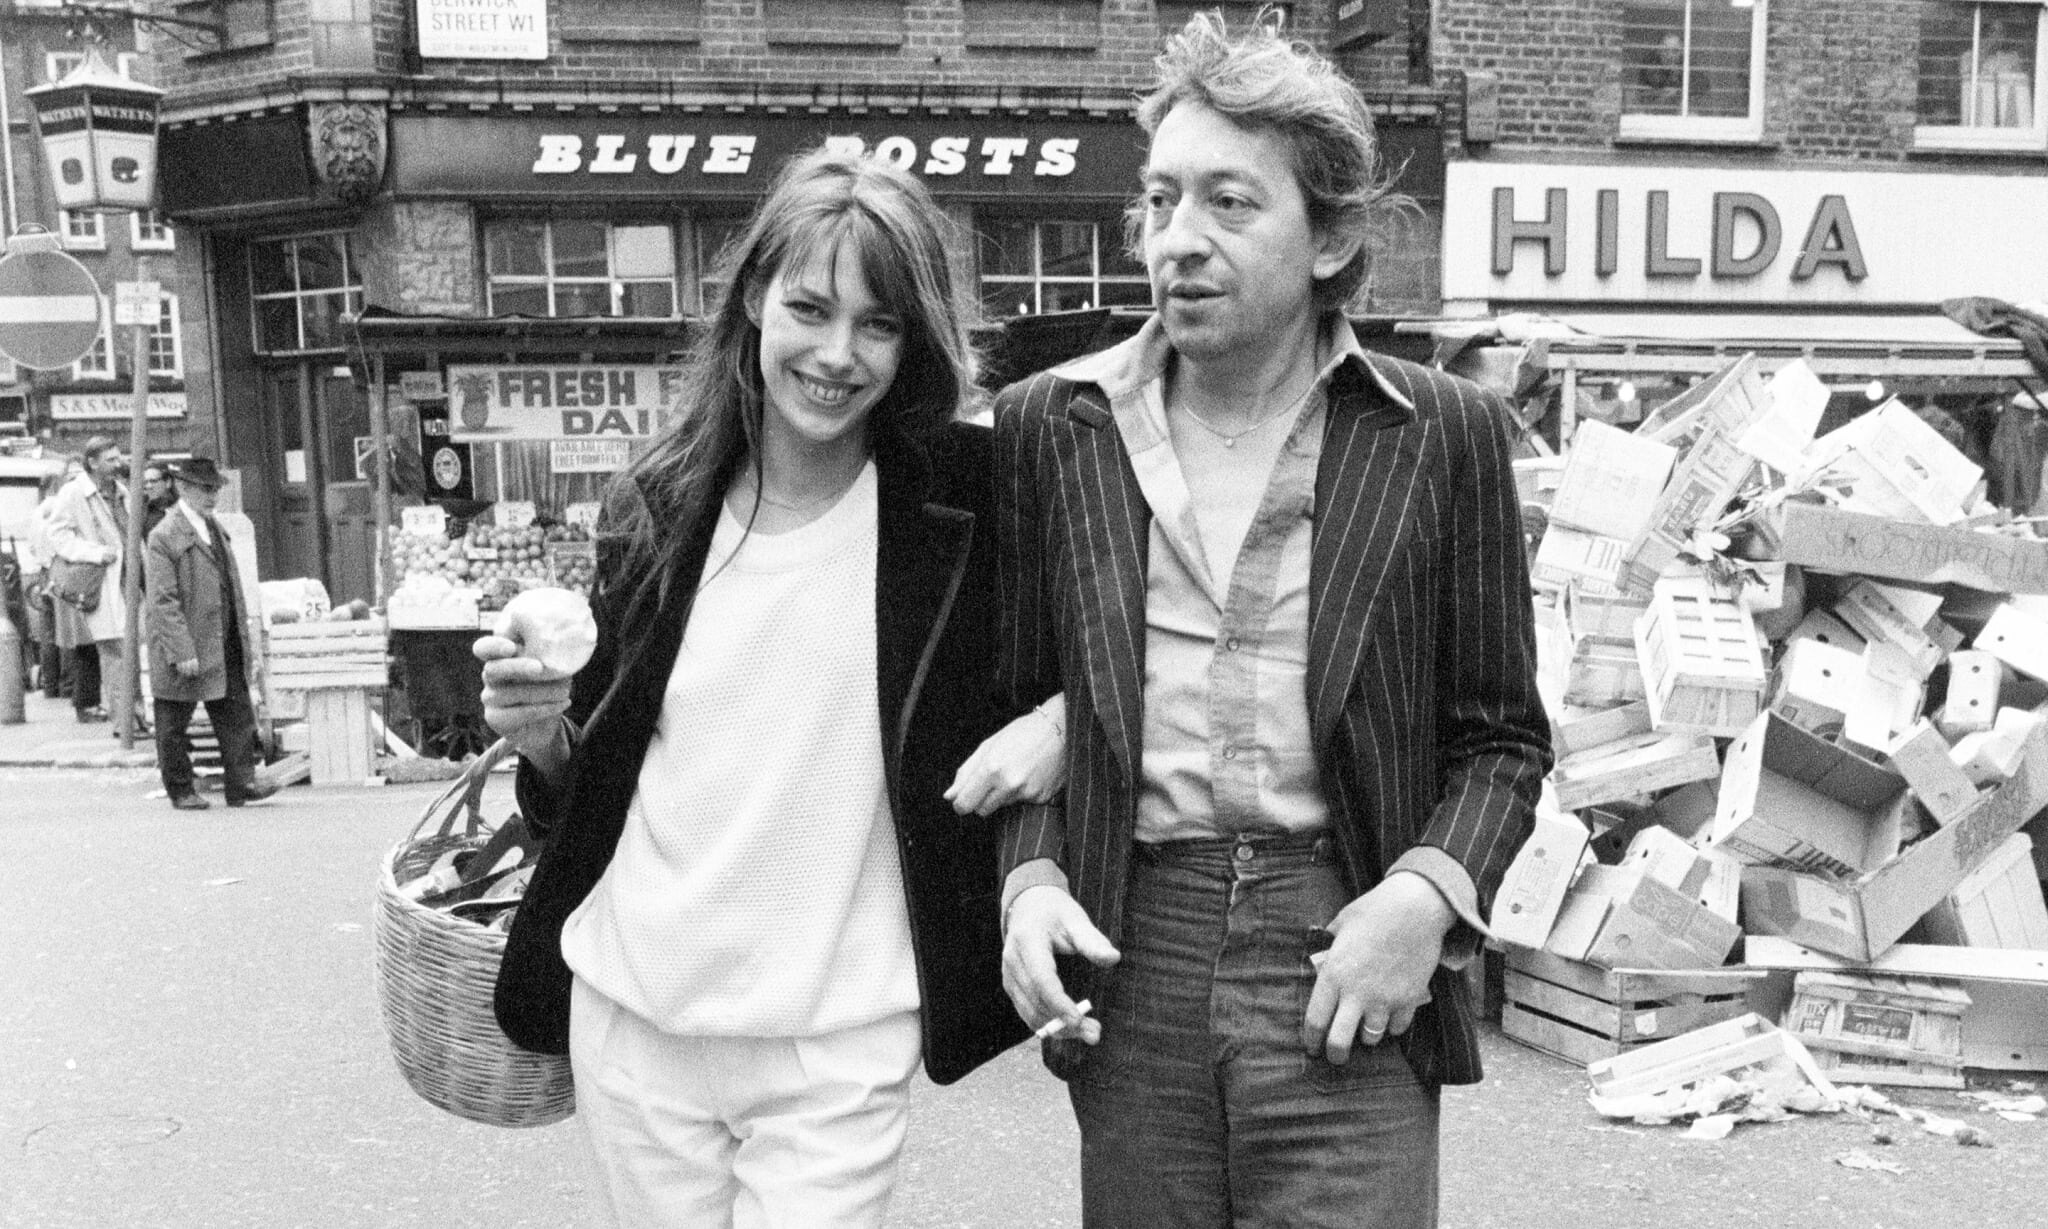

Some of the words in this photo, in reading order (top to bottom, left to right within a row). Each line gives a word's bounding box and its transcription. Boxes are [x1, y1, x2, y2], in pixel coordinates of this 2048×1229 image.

[432, 13, 498, 32] STREET
[508, 14, 534, 32] W1
[92, 106, 154, 121] WATNEYS
[532, 134, 758, 174] BLUE
[1491, 187, 1868, 283] HILDA
[498, 371, 636, 407] FRESH
[305, 601, 322, 618] 25
